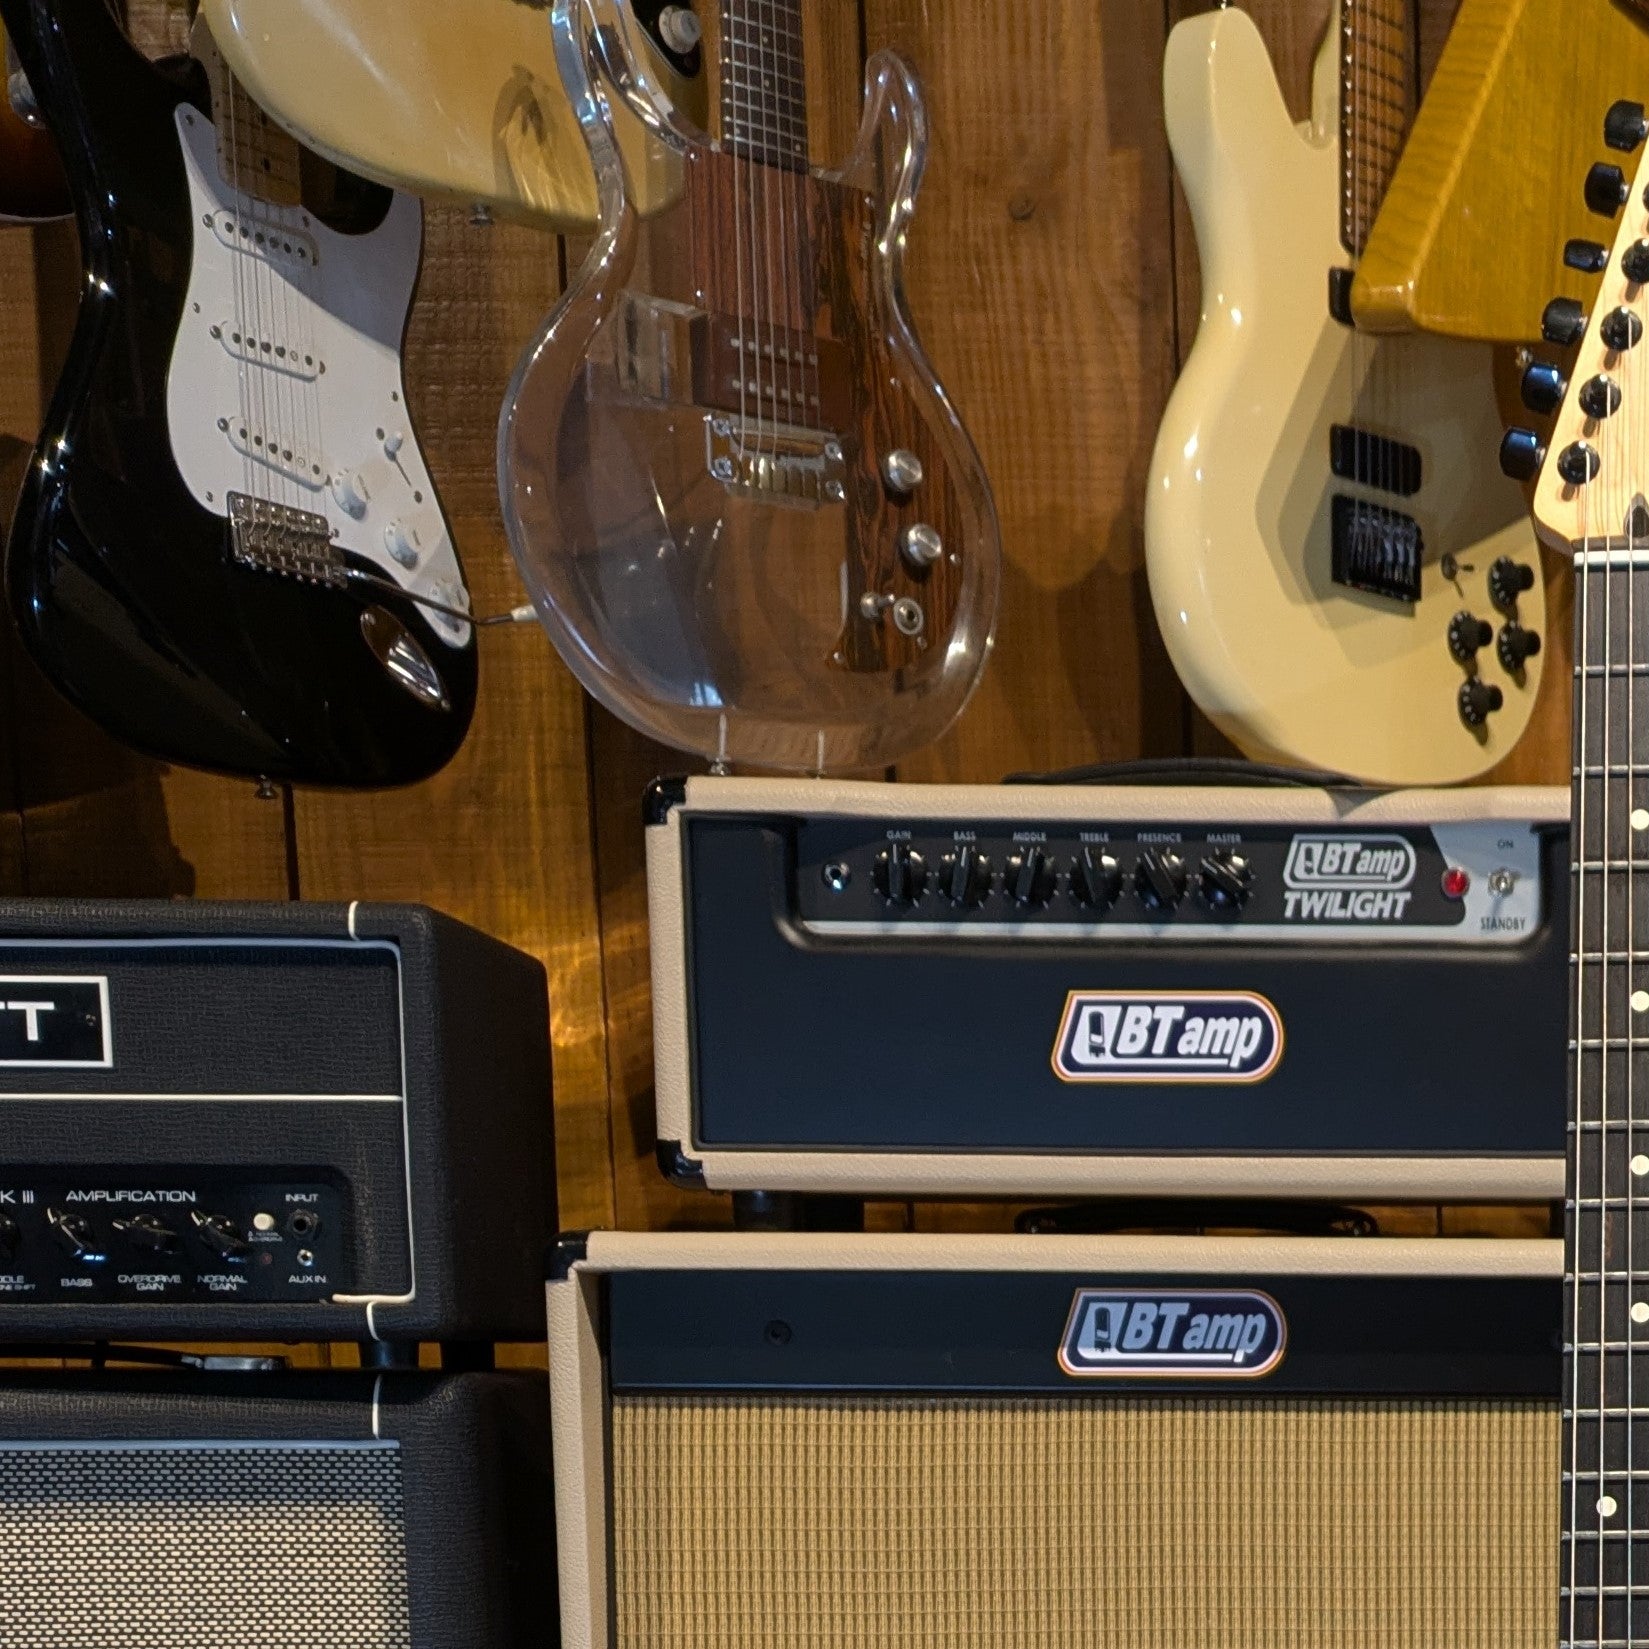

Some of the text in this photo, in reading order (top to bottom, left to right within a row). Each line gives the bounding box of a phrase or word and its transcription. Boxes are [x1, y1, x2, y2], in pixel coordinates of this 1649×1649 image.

[886, 830, 912, 840] GAIN
[953, 831, 977, 841] BASS
[1012, 832, 1047, 843] MIDDLE
[1079, 832, 1110, 843] TREBLE
[1137, 832, 1182, 843] PRESENCE
[1206, 833, 1242, 844] MASTER
[1497, 839, 1514, 849] ON
[1284, 890, 1412, 919] TWILIGHT
[1480, 916, 1526, 931] STANDBY
[22, 1189, 34, 1204] III
[66, 1189, 197, 1202] AMPLIFICATION
[285, 1193, 319, 1202] INPUT
[60, 1278, 93, 1287] BASS
[117, 1274, 181, 1283] OVERDRIVE
[197, 1274, 247, 1284] NORMAL
[288, 1274, 327, 1284] AUX IN
[136, 1282, 164, 1291] GAIN
[209, 1282, 238, 1291] GAIN
